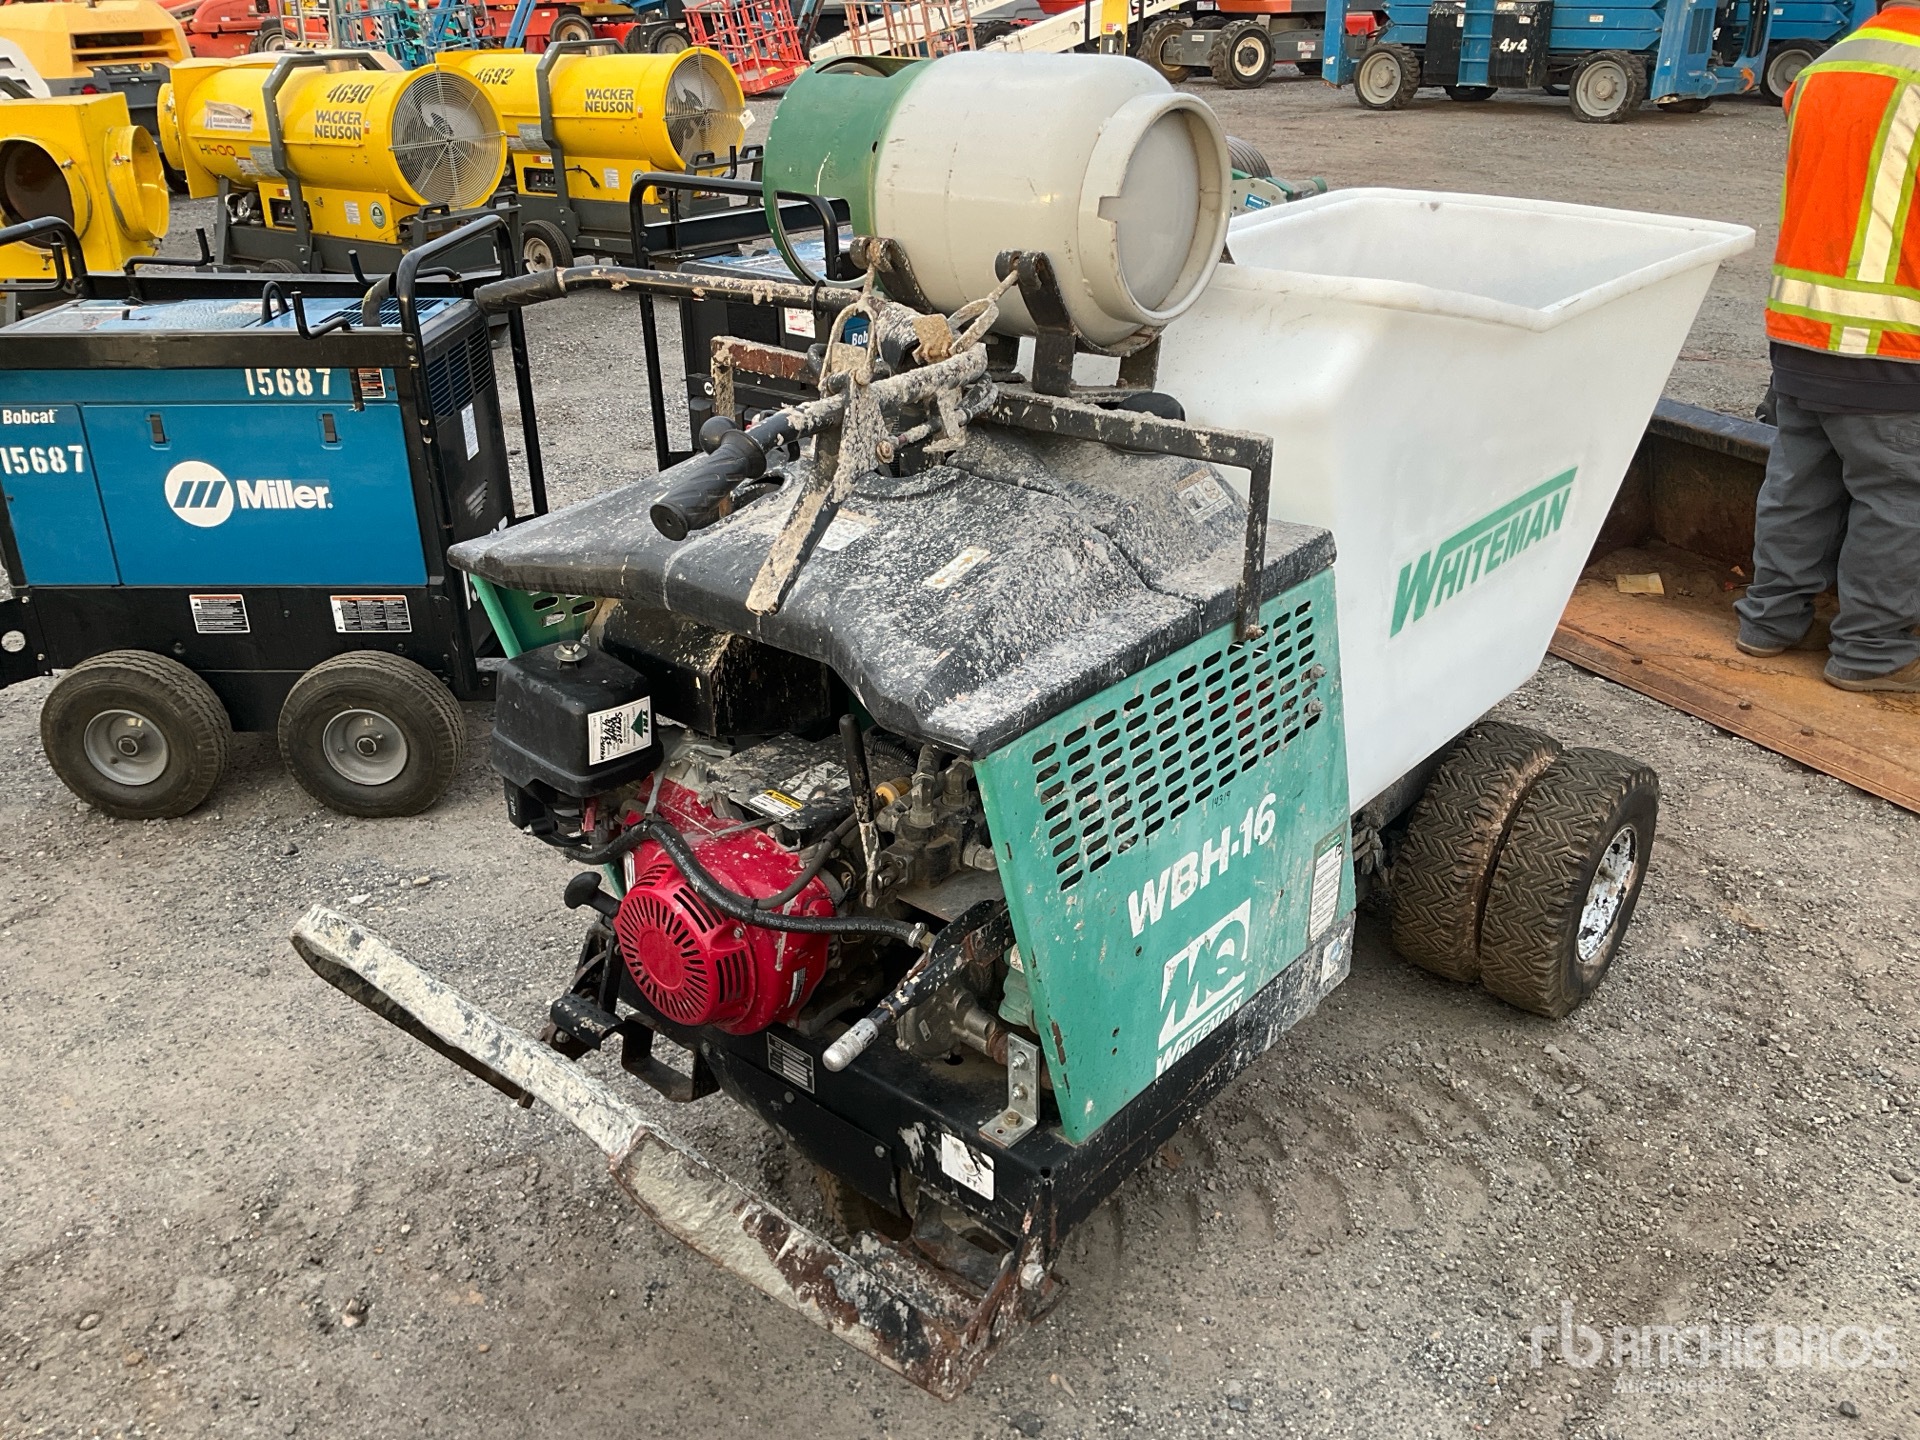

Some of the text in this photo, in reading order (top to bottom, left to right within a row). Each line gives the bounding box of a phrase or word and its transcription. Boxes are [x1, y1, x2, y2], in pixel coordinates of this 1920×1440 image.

[1499, 37, 1528, 53] 4x4
[326, 83, 375, 104] 4690
[585, 88, 634, 101] WACKER
[585, 101, 634, 113] NEUSON
[315, 109, 362, 126] WACKER
[314, 125, 362, 141] NEUSON
[244, 368, 331, 396] 15687
[2, 409, 56, 425] Bobcat
[0, 445, 84, 475] 15687
[1390, 466, 1579, 639] WHITEMAN
[1127, 793, 1276, 939] WBH-16
[1156, 986, 1244, 1078] WHITEMAN
